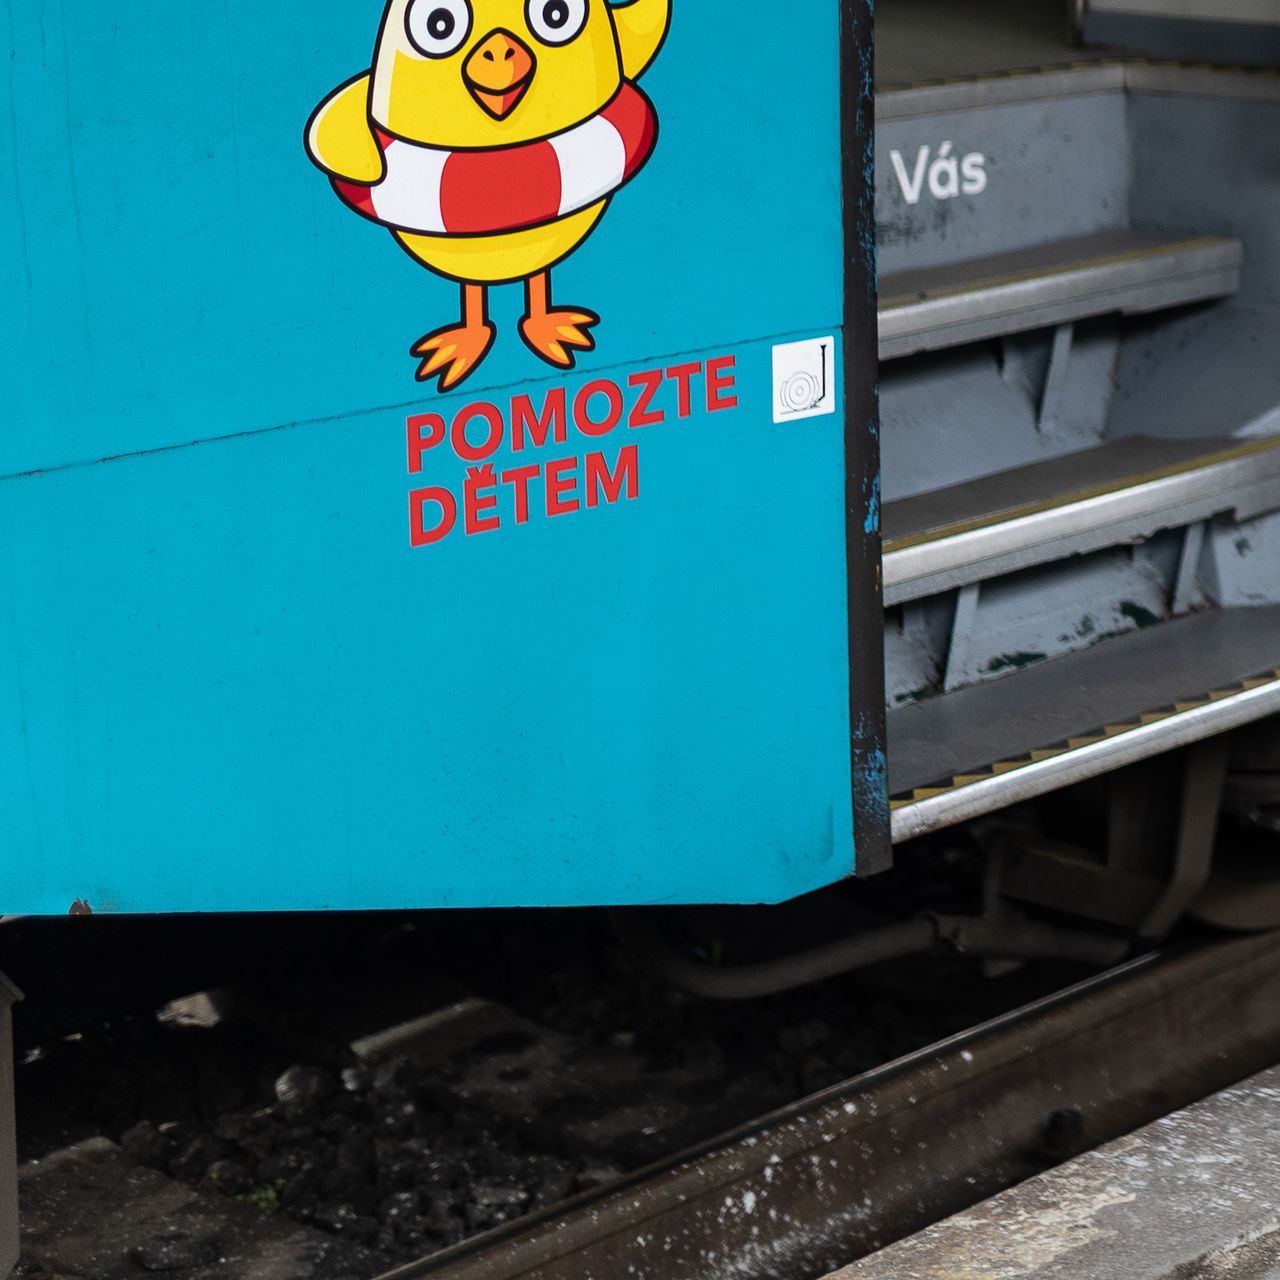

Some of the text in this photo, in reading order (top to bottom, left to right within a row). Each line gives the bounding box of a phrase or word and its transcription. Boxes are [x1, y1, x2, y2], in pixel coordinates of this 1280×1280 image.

[889, 140, 987, 204] Vás
[406, 355, 739, 474] POMOZTE
[409, 444, 639, 549] DĚTEM
